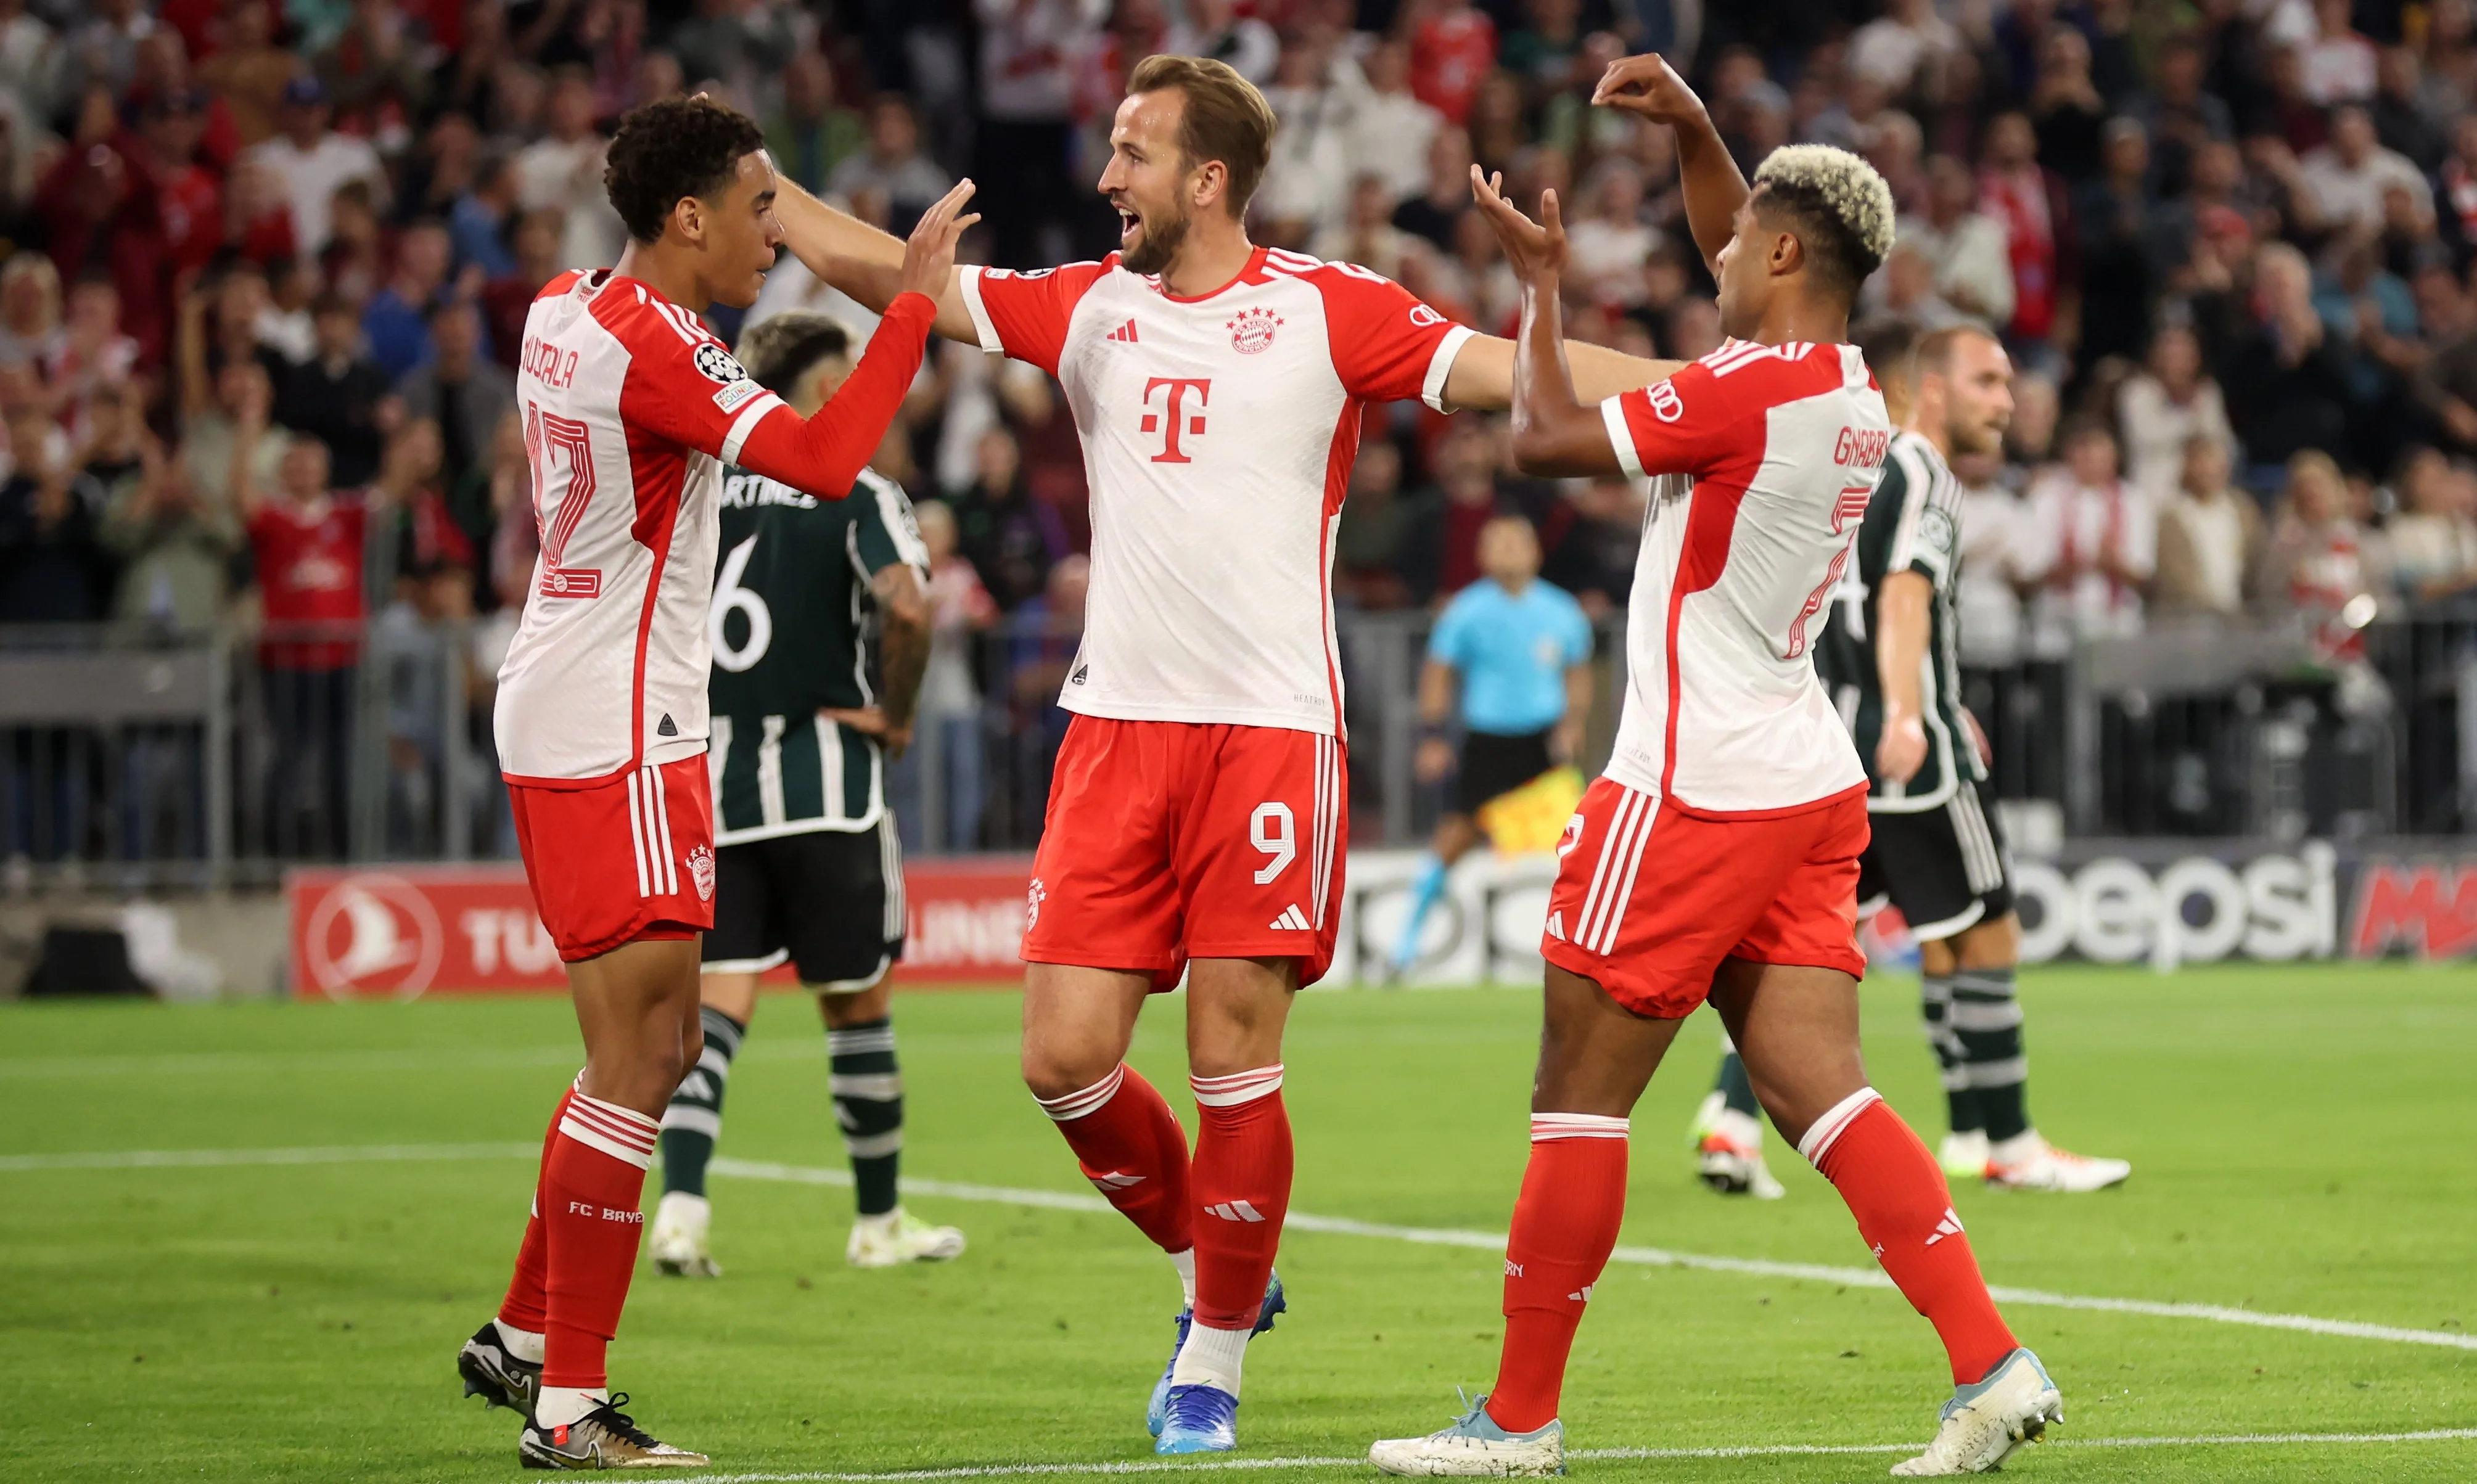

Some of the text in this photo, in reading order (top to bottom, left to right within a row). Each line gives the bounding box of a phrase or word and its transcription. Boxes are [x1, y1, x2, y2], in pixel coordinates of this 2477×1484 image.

[709, 532, 773, 673] 6
[1250, 801, 1296, 885] 9
[569, 1201, 644, 1223] FC BAYE
